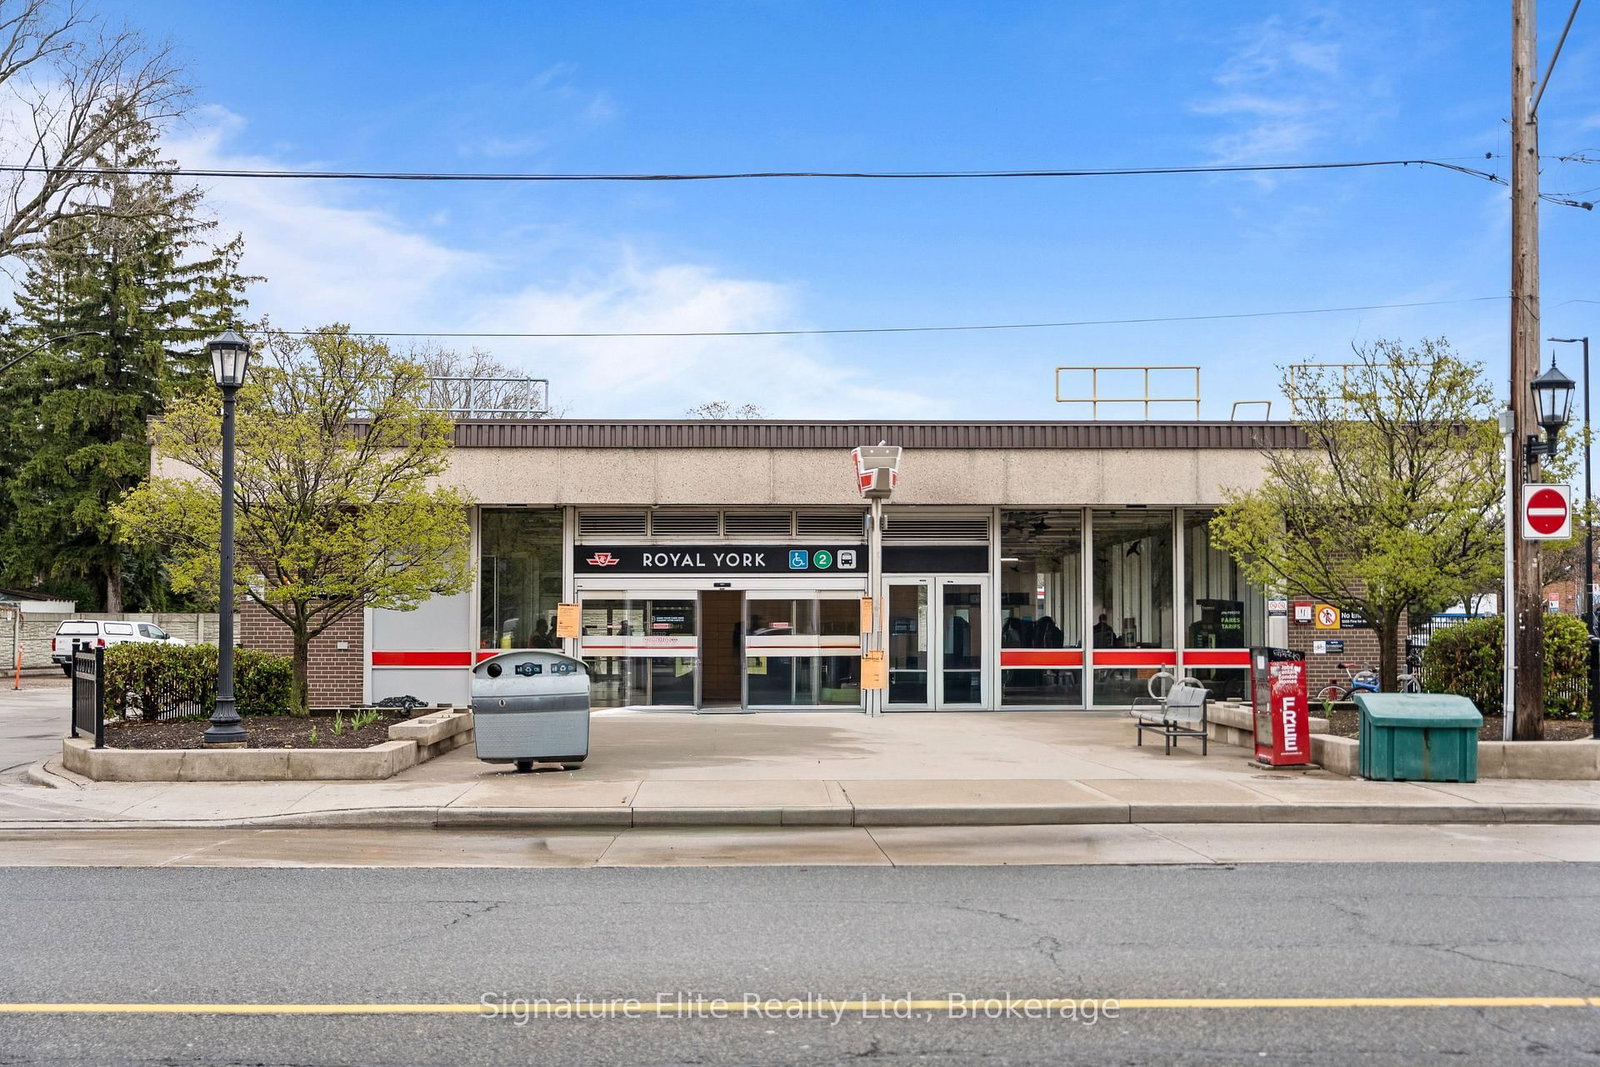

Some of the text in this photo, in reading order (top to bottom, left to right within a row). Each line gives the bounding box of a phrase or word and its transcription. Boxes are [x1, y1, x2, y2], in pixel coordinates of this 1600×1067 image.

[643, 553, 766, 567] ROYAL YORK
[819, 554, 827, 565] 2
[1282, 696, 1299, 752] FREE
